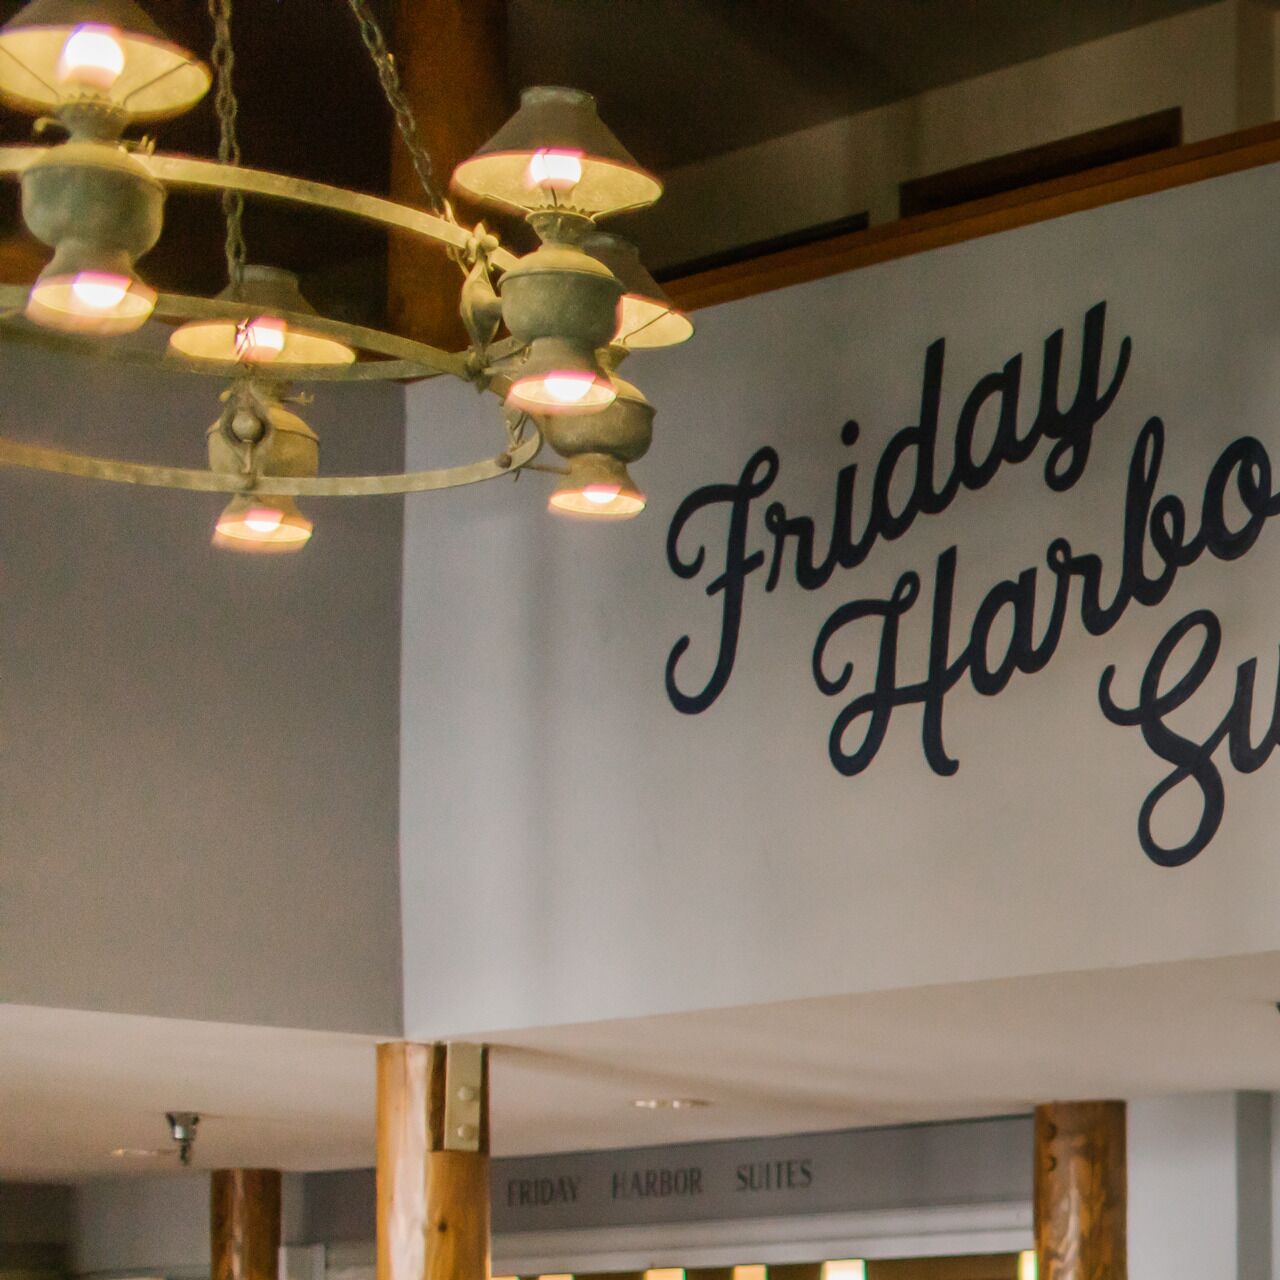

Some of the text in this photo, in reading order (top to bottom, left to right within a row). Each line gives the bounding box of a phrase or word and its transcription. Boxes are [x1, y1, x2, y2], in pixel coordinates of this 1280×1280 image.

[665, 299, 1133, 715] Friday
[507, 1158, 814, 1206] FRIDAY HARBOR SUITES
